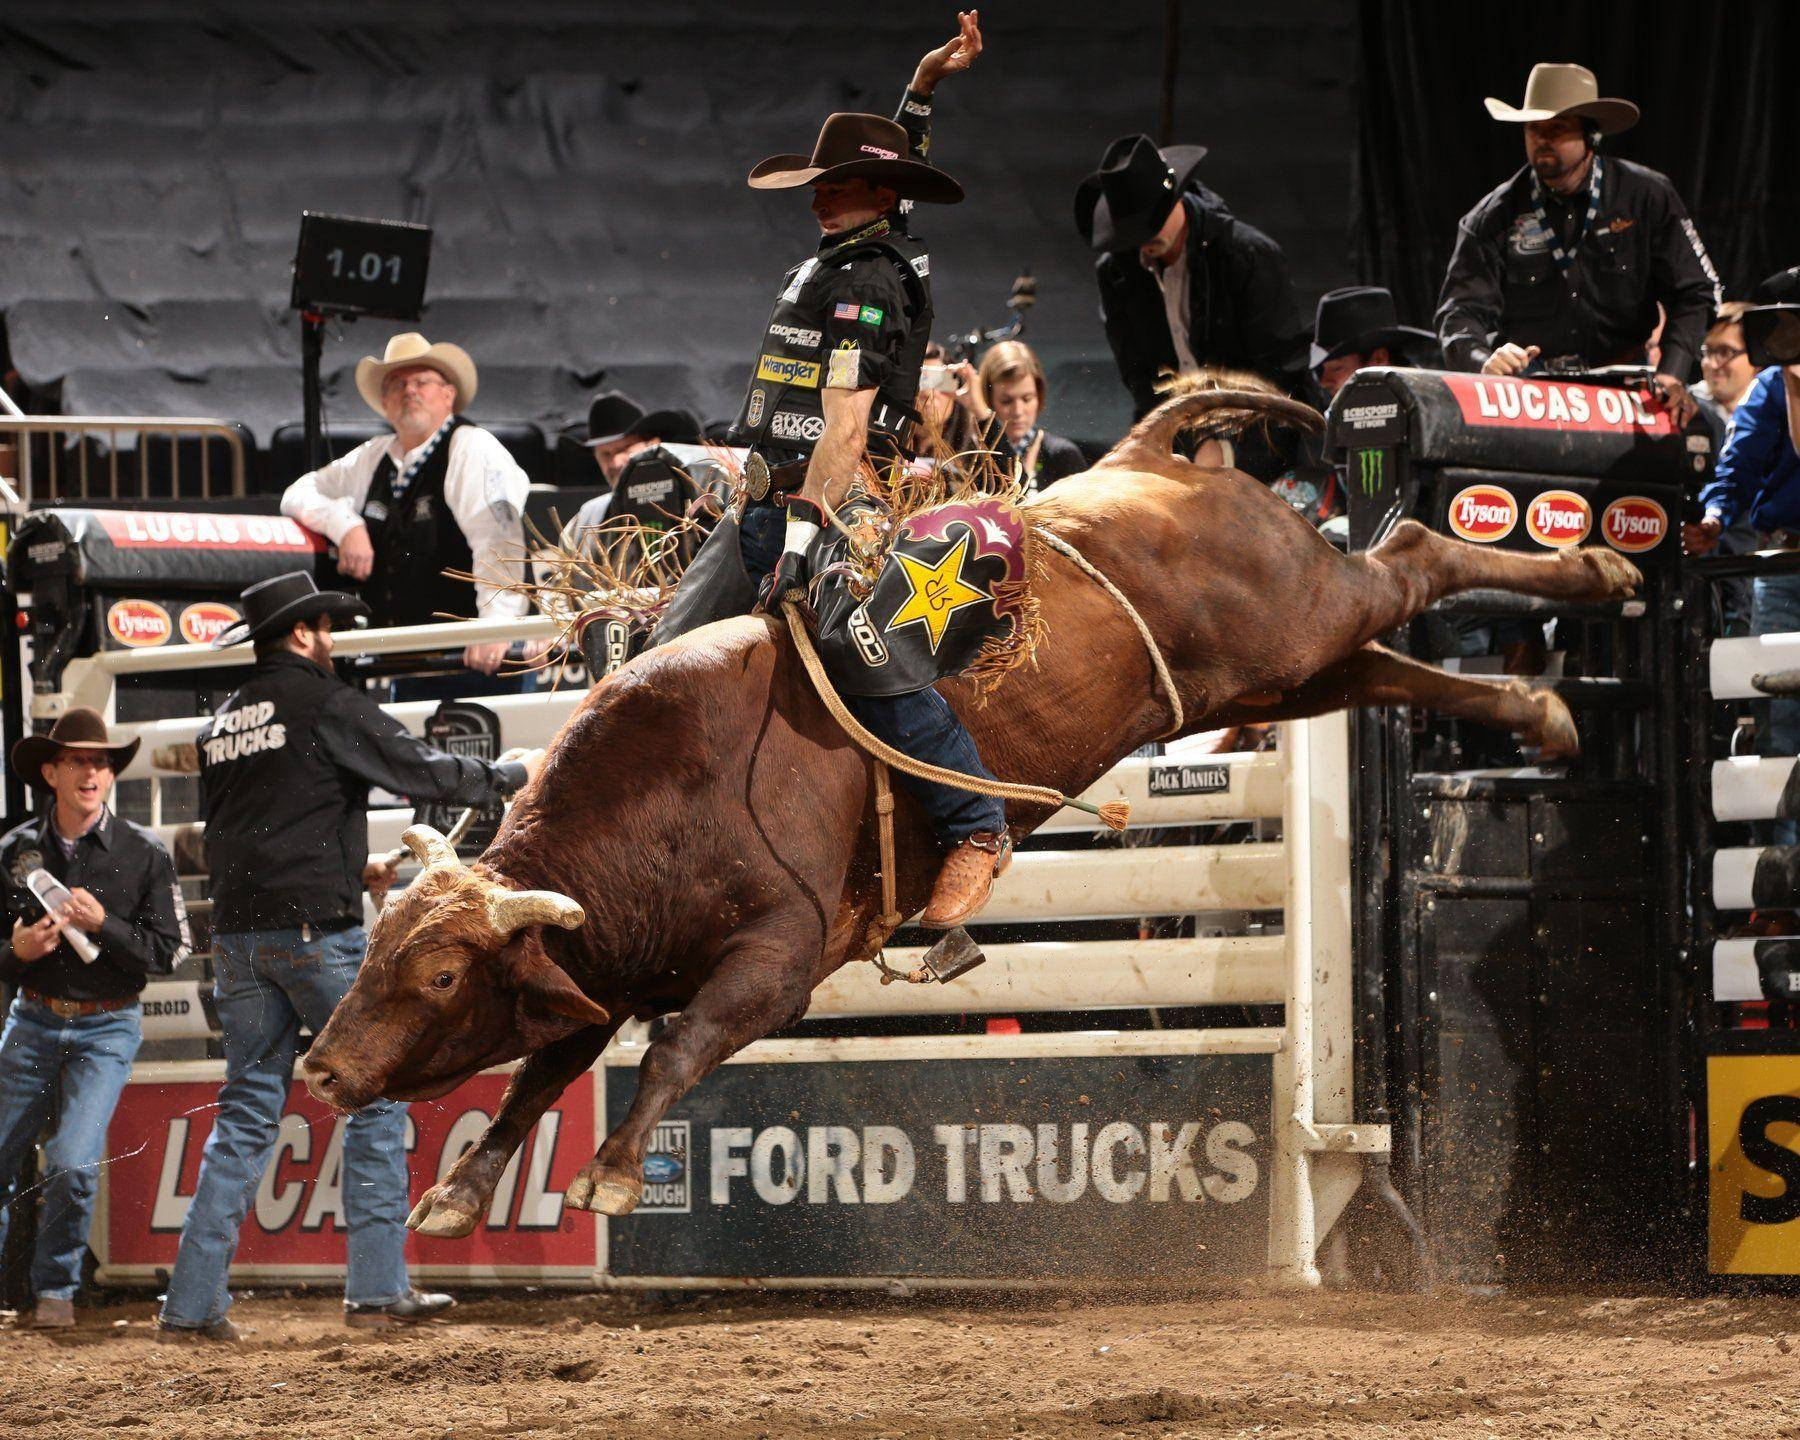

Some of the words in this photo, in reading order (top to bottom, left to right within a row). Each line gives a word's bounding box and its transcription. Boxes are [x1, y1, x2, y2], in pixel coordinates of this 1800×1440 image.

[326, 248, 402, 285] 1.01
[769, 324, 823, 340] COOPER
[785, 336, 821, 348] TIRES
[763, 355, 817, 382] Wrangler
[1474, 381, 1592, 424] LUCAS
[1596, 387, 1656, 426] OIL
[1458, 496, 1512, 529] Tyson
[1536, 501, 1587, 534] Tyson
[1611, 507, 1661, 540] Tyson
[124, 513, 240, 545] LUCAS
[245, 518, 307, 546] OIL
[115, 610, 166, 637] Tyson
[211, 700, 275, 738] FORD
[202, 723, 287, 767] TRUCKS
[1150, 766, 1180, 791] JACK
[1181, 767, 1228, 789] DANIEL'S
[646, 1127, 686, 1154] UILT
[151, 1111, 417, 1234] LCA
[709, 1125, 916, 1206] FORD
[934, 1121, 1259, 1204] TRUCKS
[642, 1183, 686, 1205] OUGH
